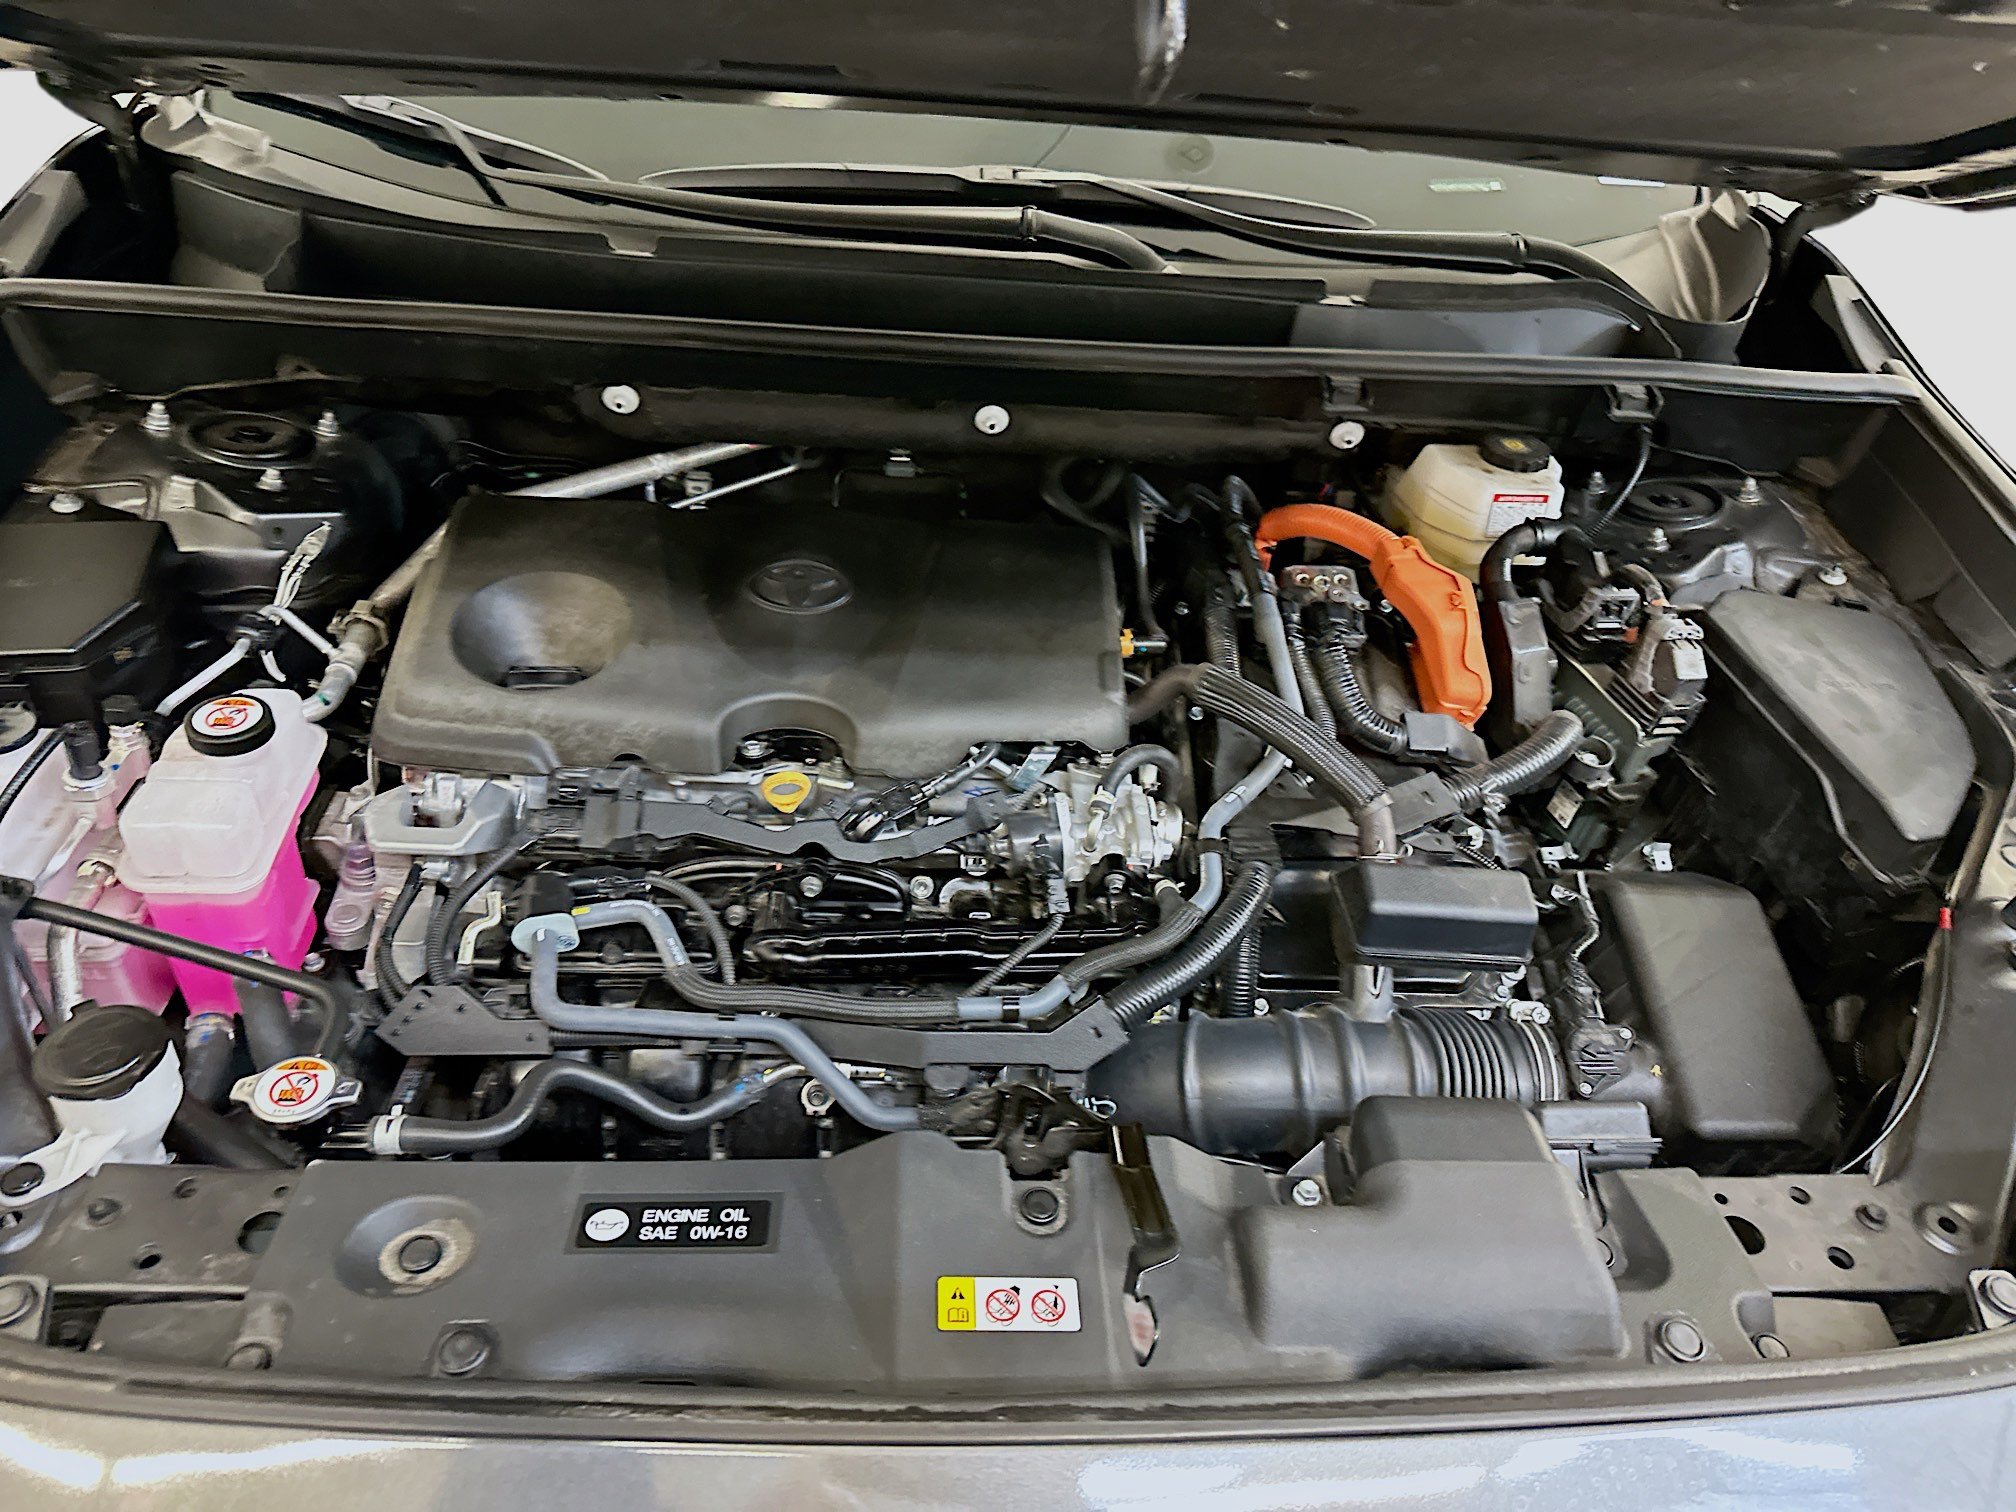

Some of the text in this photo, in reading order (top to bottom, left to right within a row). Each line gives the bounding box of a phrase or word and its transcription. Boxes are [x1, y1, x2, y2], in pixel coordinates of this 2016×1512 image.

[642, 1208, 750, 1223] ENGINE OIL
[638, 1225, 747, 1240] SAE 0W-16
